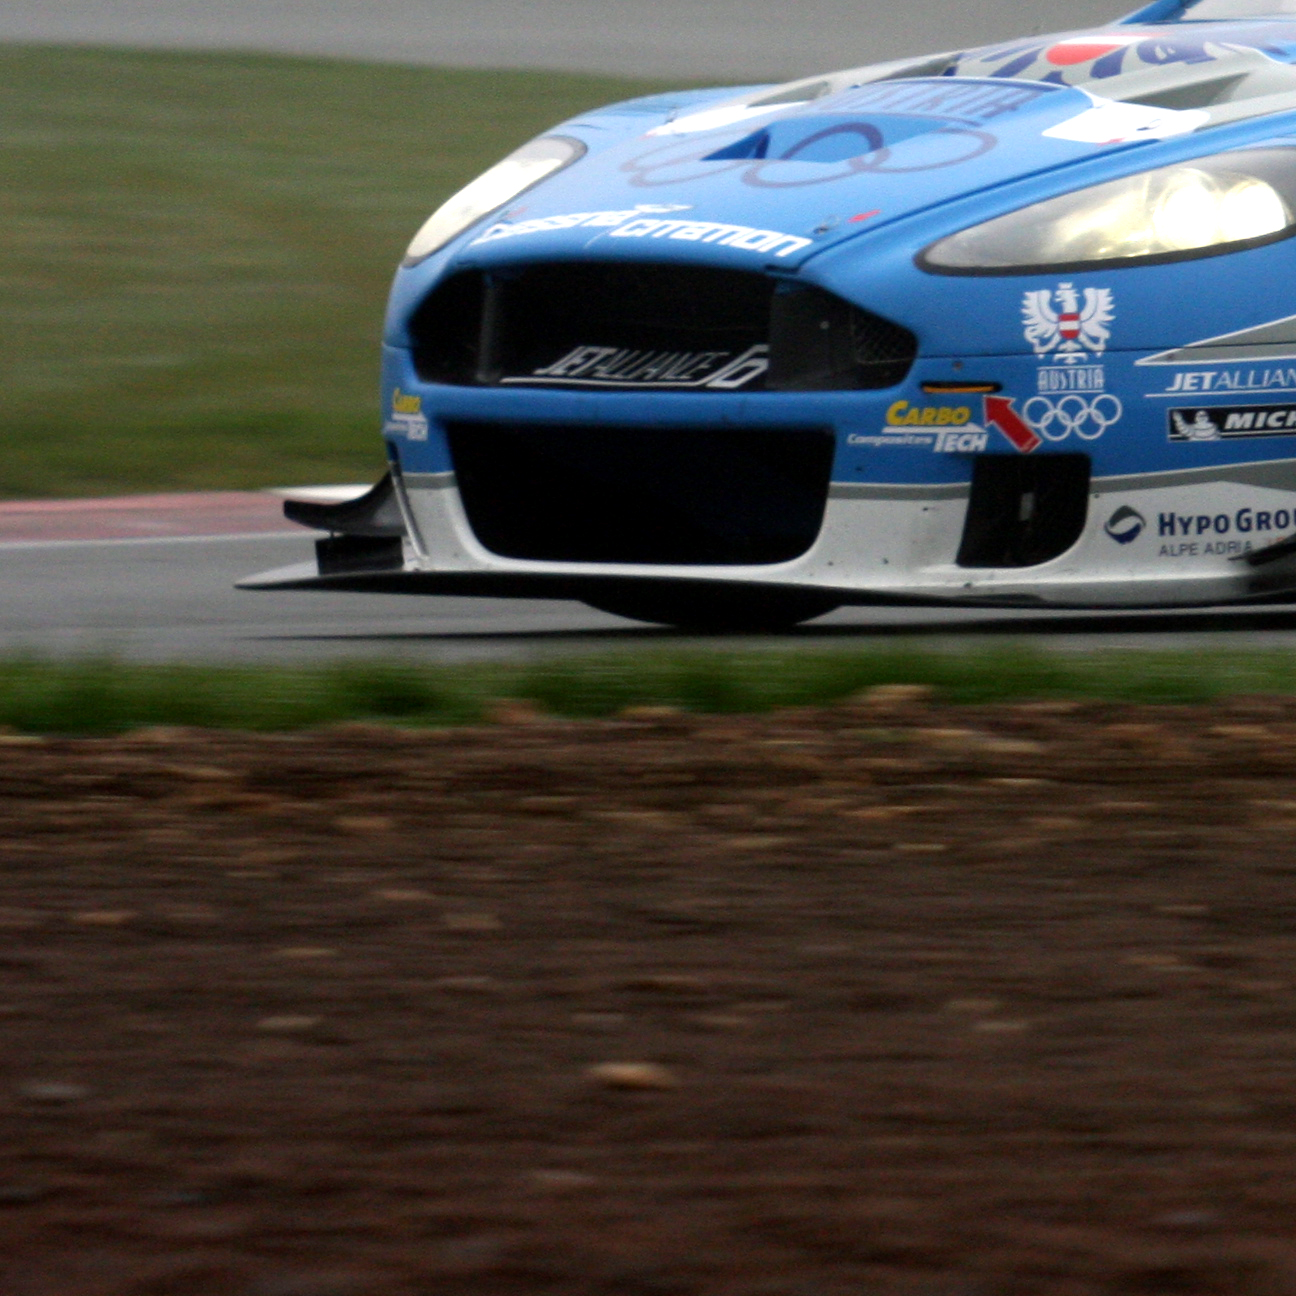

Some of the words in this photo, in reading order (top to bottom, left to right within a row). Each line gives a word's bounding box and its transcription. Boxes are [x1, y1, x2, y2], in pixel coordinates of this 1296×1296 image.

[1037, 367, 1105, 391] AUSTRIA
[885, 400, 971, 426] CARBO
[933, 432, 988, 453] TECH
[1158, 542, 1198, 557] ALPE
[1204, 540, 1253, 555] ADRIA
